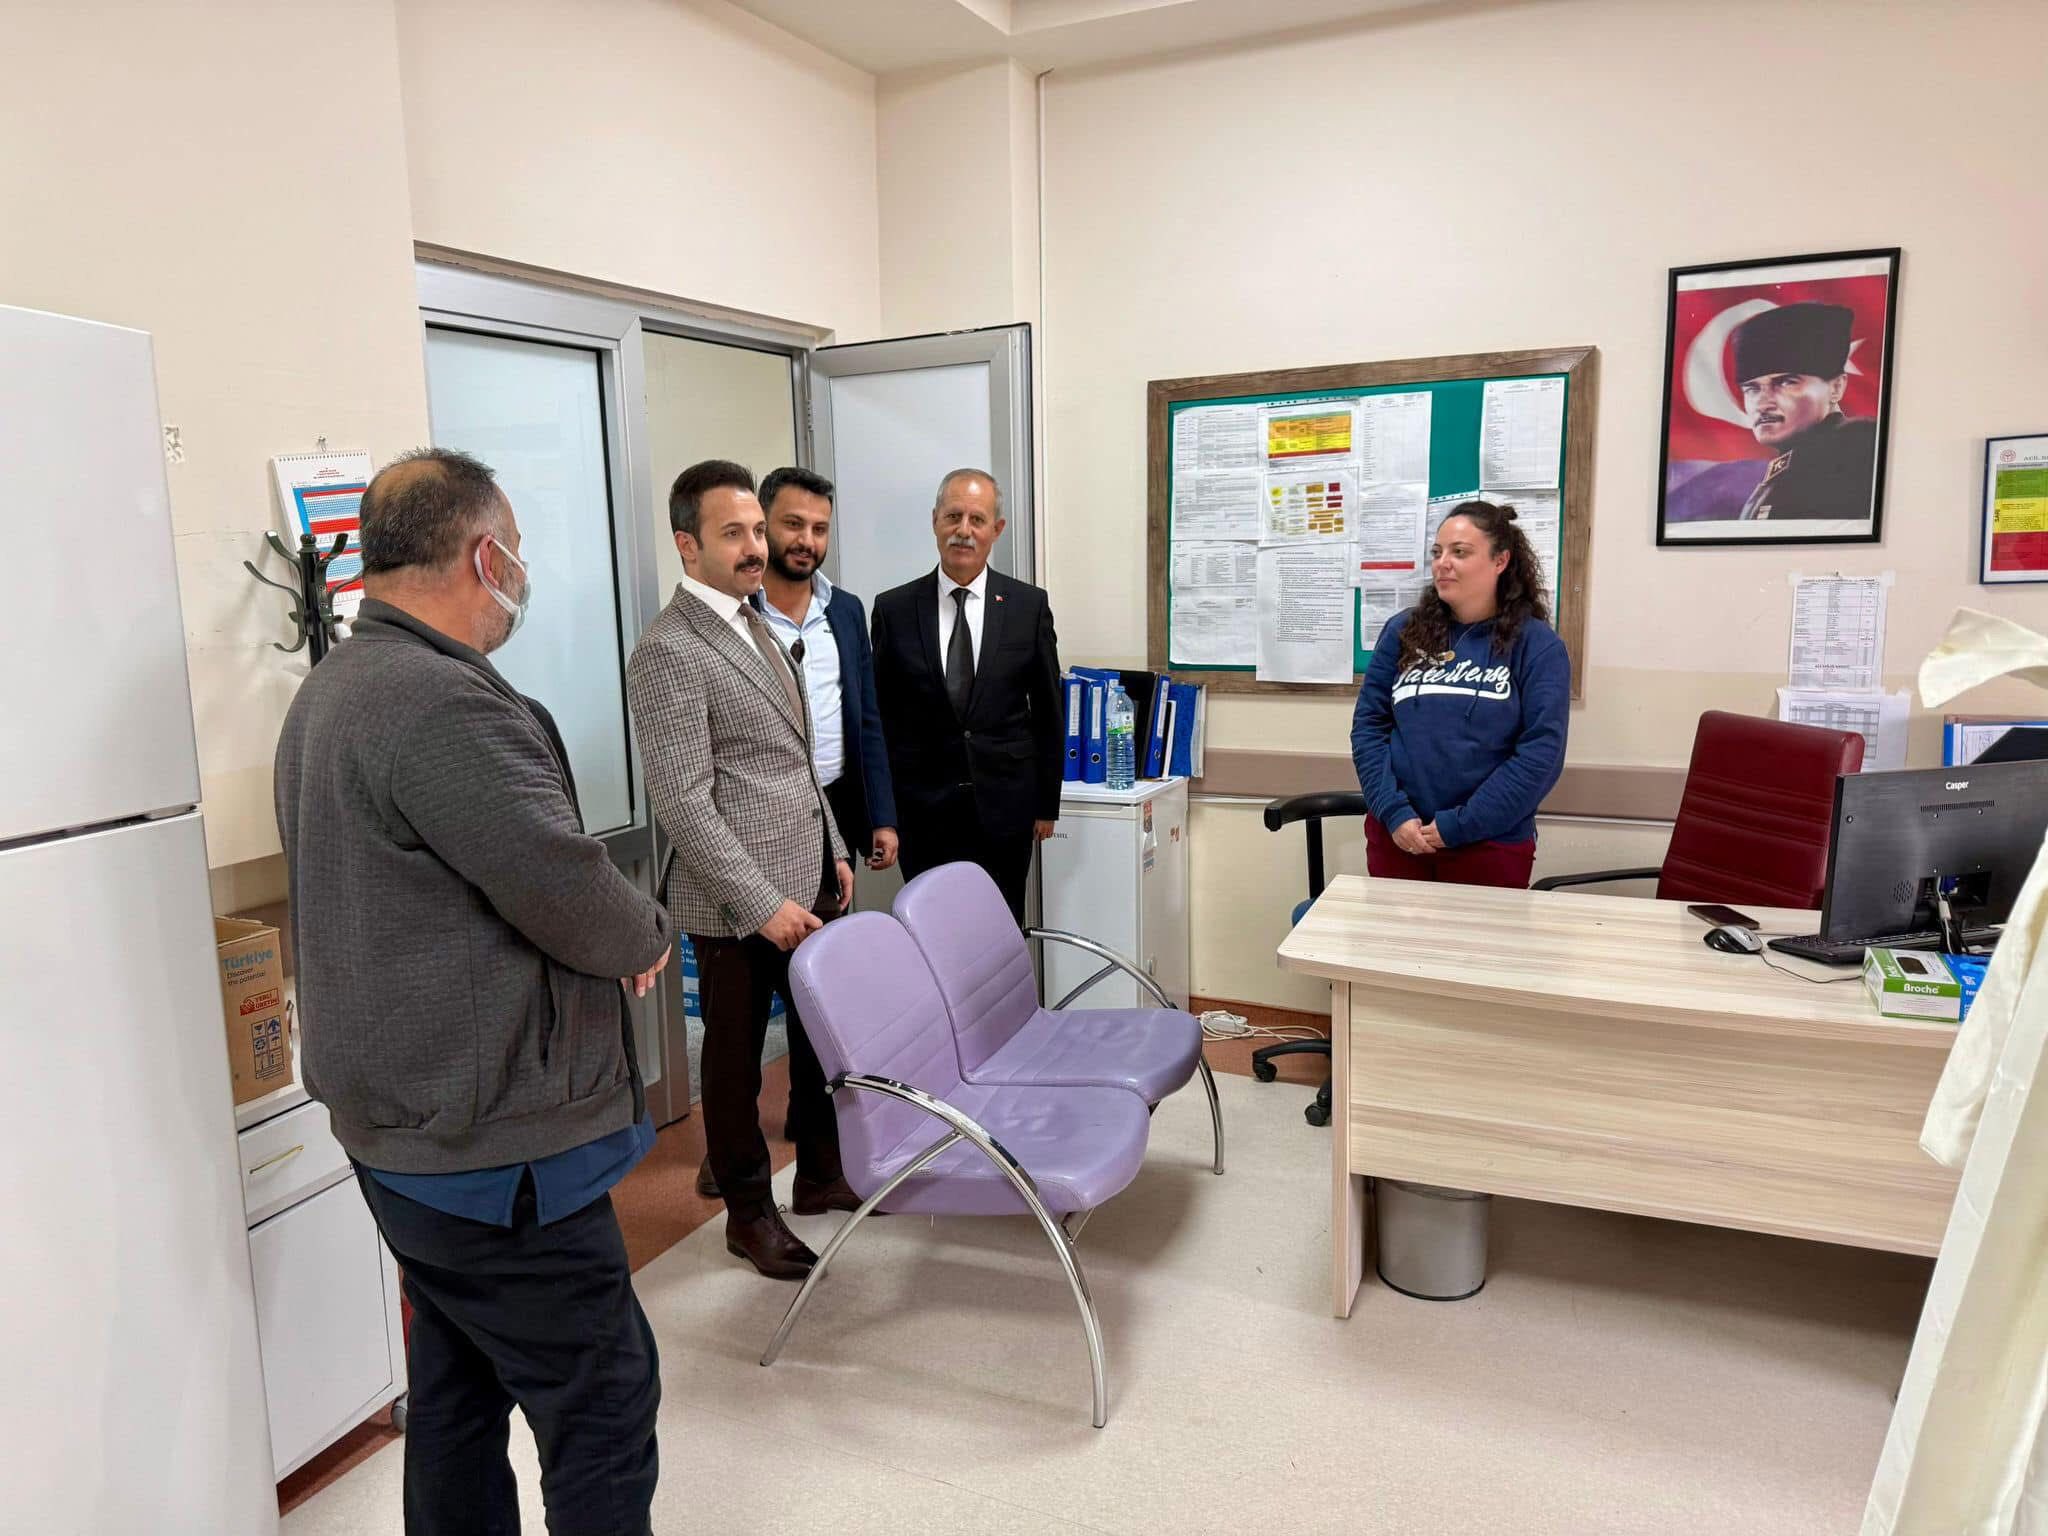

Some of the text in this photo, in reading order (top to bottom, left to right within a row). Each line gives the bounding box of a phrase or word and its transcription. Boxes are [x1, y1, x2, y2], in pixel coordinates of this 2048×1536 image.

[1945, 780, 1969, 791] Casper
[224, 949, 274, 969] Türkiye
[227, 967, 254, 979] Discover
[239, 971, 266, 984] potential
